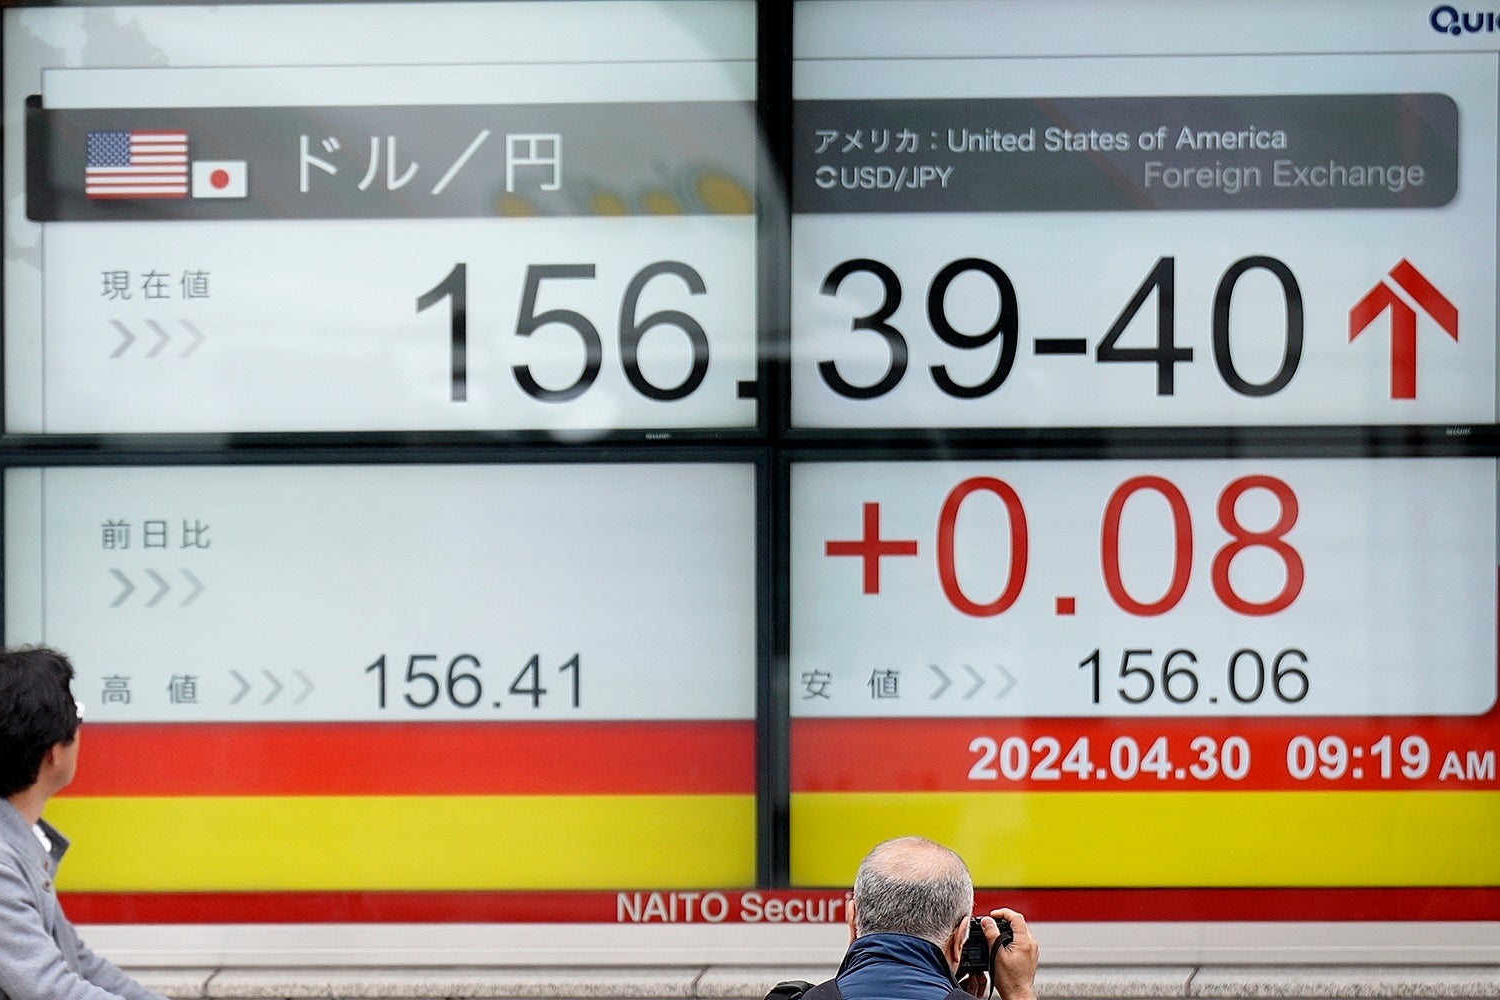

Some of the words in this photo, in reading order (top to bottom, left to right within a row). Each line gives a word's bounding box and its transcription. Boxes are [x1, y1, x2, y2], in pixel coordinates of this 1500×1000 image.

[947, 127, 1036, 153] United
[1043, 126, 1131, 152] States
[1138, 125, 1168, 151] of
[1176, 125, 1288, 150] America
[841, 165, 954, 192] USD/JPY
[1144, 160, 1262, 193] Foreign
[1273, 159, 1426, 190] Exchange
[101, 269, 210, 301] 現在値
[100, 518, 211, 550] 前日比
[824, 474, 1306, 618] +0.08
[365, 652, 581, 709] 156.41
[1077, 648, 1311, 705] 156.06
[967, 736, 1251, 781] 2024.04.30
[1286, 736, 1431, 781] 09:19
[1438, 750, 1496, 781] AM
[616, 891, 729, 922] NAITO
[740, 891, 852, 923] Securi
